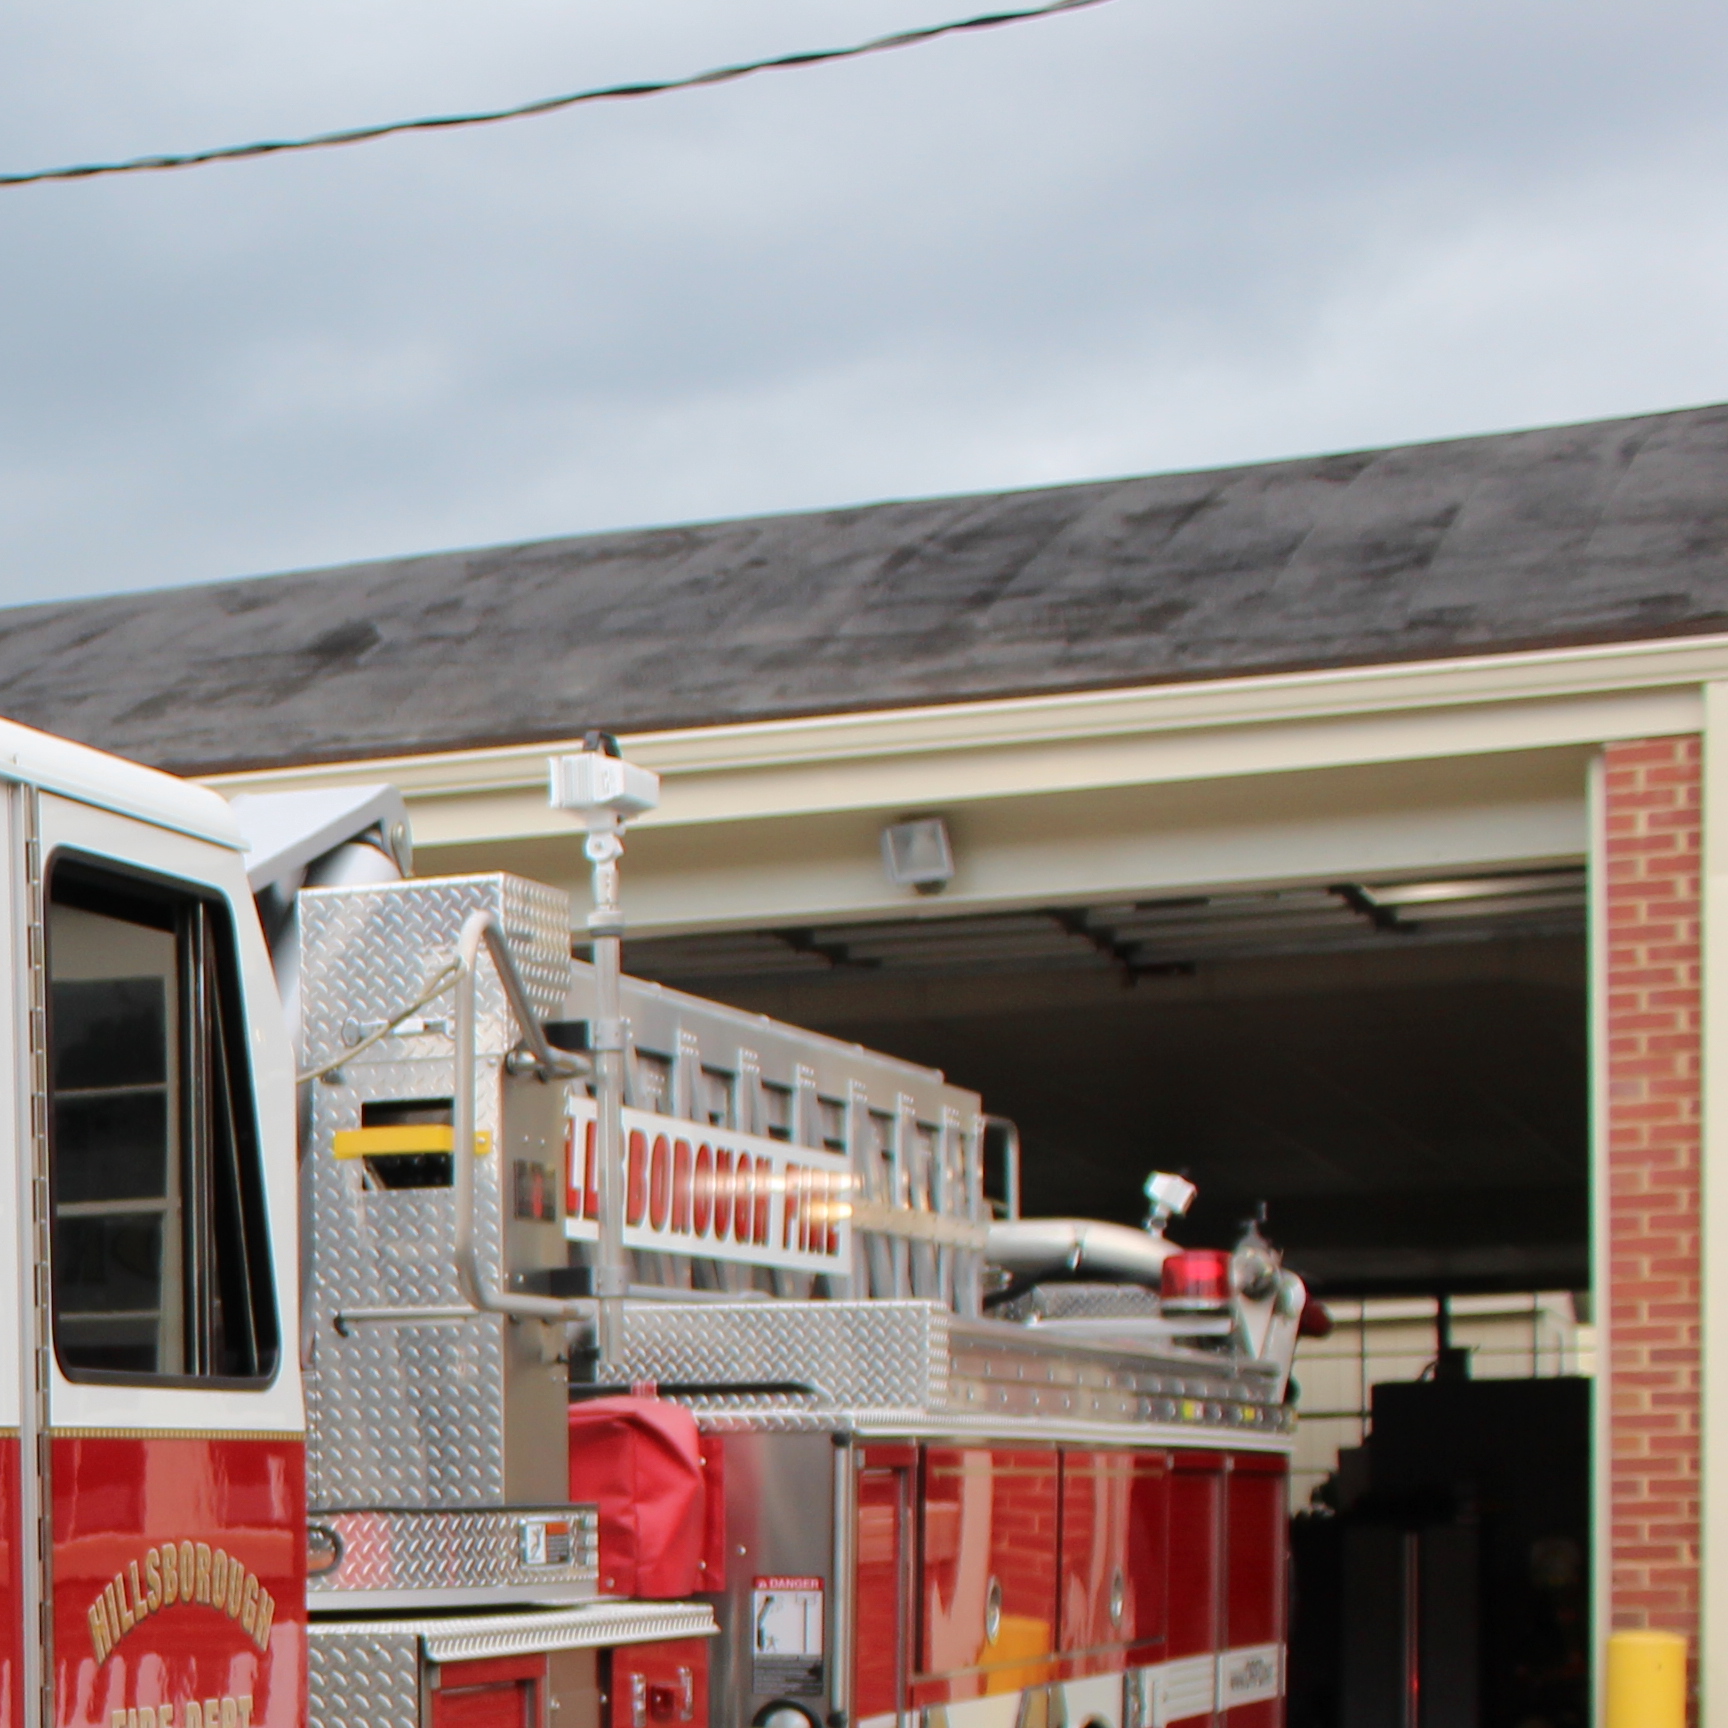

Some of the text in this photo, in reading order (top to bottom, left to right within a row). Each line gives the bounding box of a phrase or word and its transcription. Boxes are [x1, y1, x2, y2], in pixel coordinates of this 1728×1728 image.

[565, 1117, 773, 1246] LLBOROUGH
[87, 1539, 276, 1668] HILLSBOROUGH
[769, 1578, 820, 1589] DANGER
